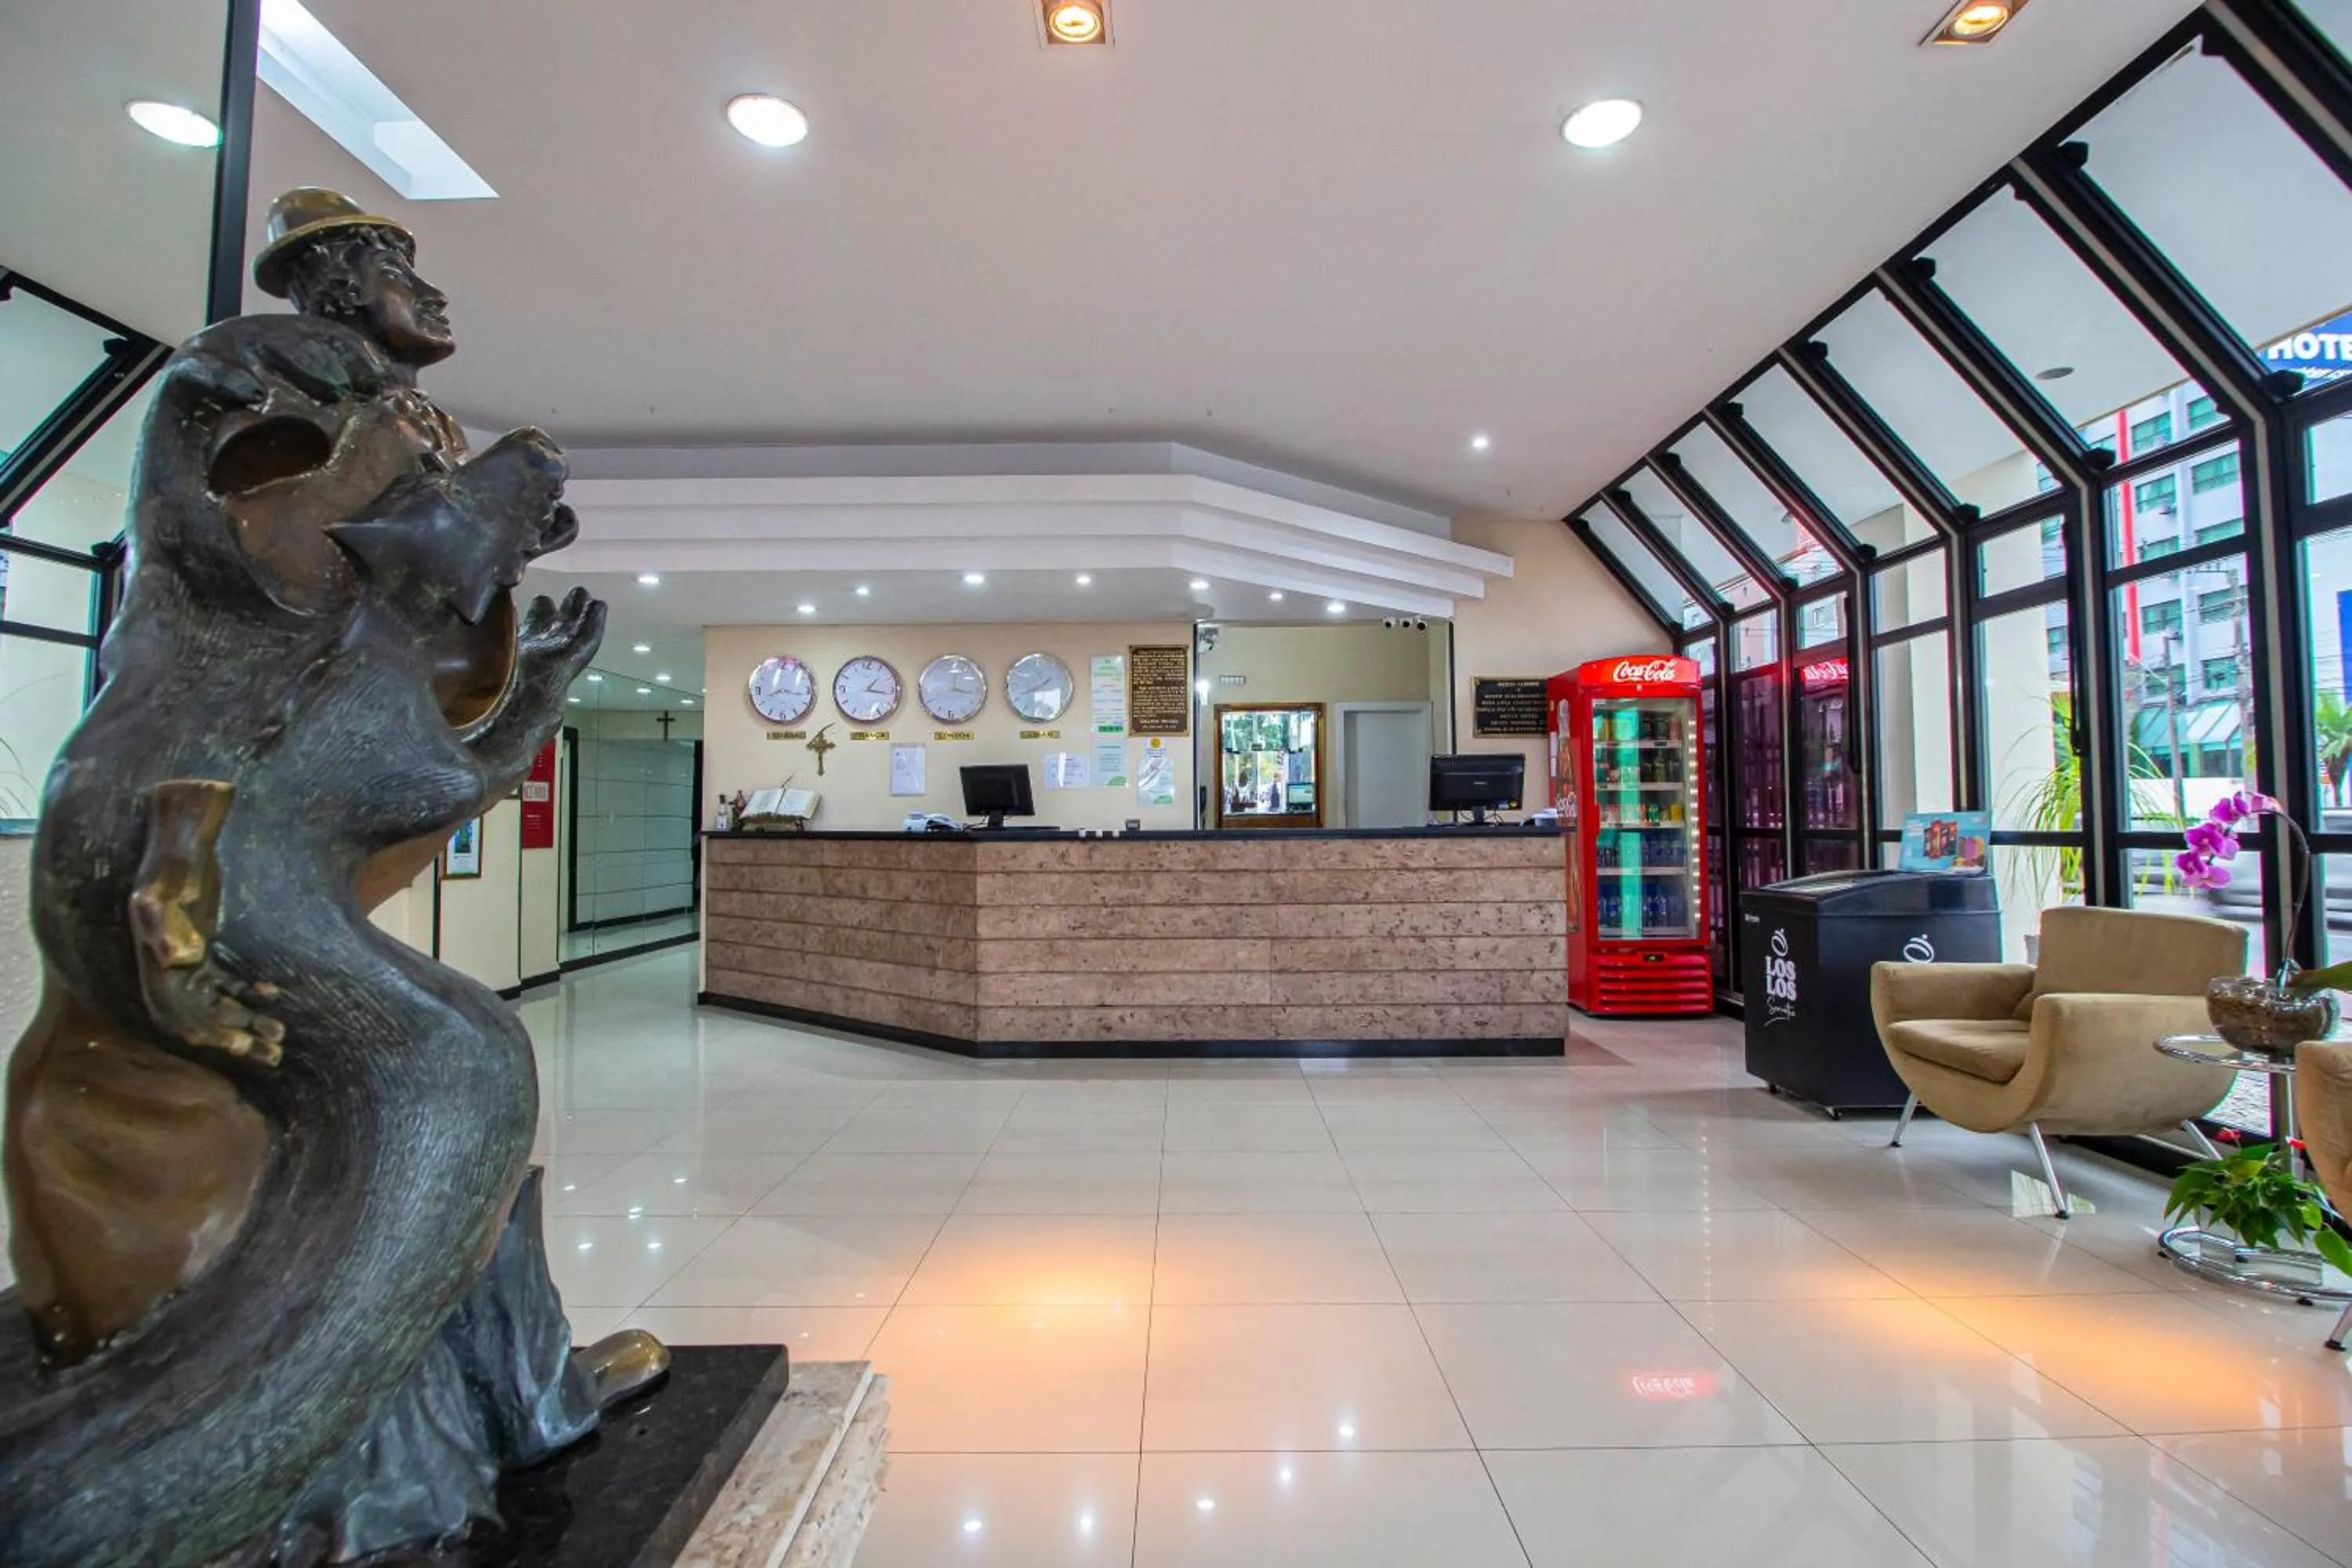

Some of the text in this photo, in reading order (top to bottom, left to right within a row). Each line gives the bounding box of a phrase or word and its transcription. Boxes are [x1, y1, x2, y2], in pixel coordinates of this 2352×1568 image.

[1613, 658, 1678, 683] Coca-Cola
[1765, 956, 1796, 981] LOS
[1766, 975, 1797, 1001] LOS
